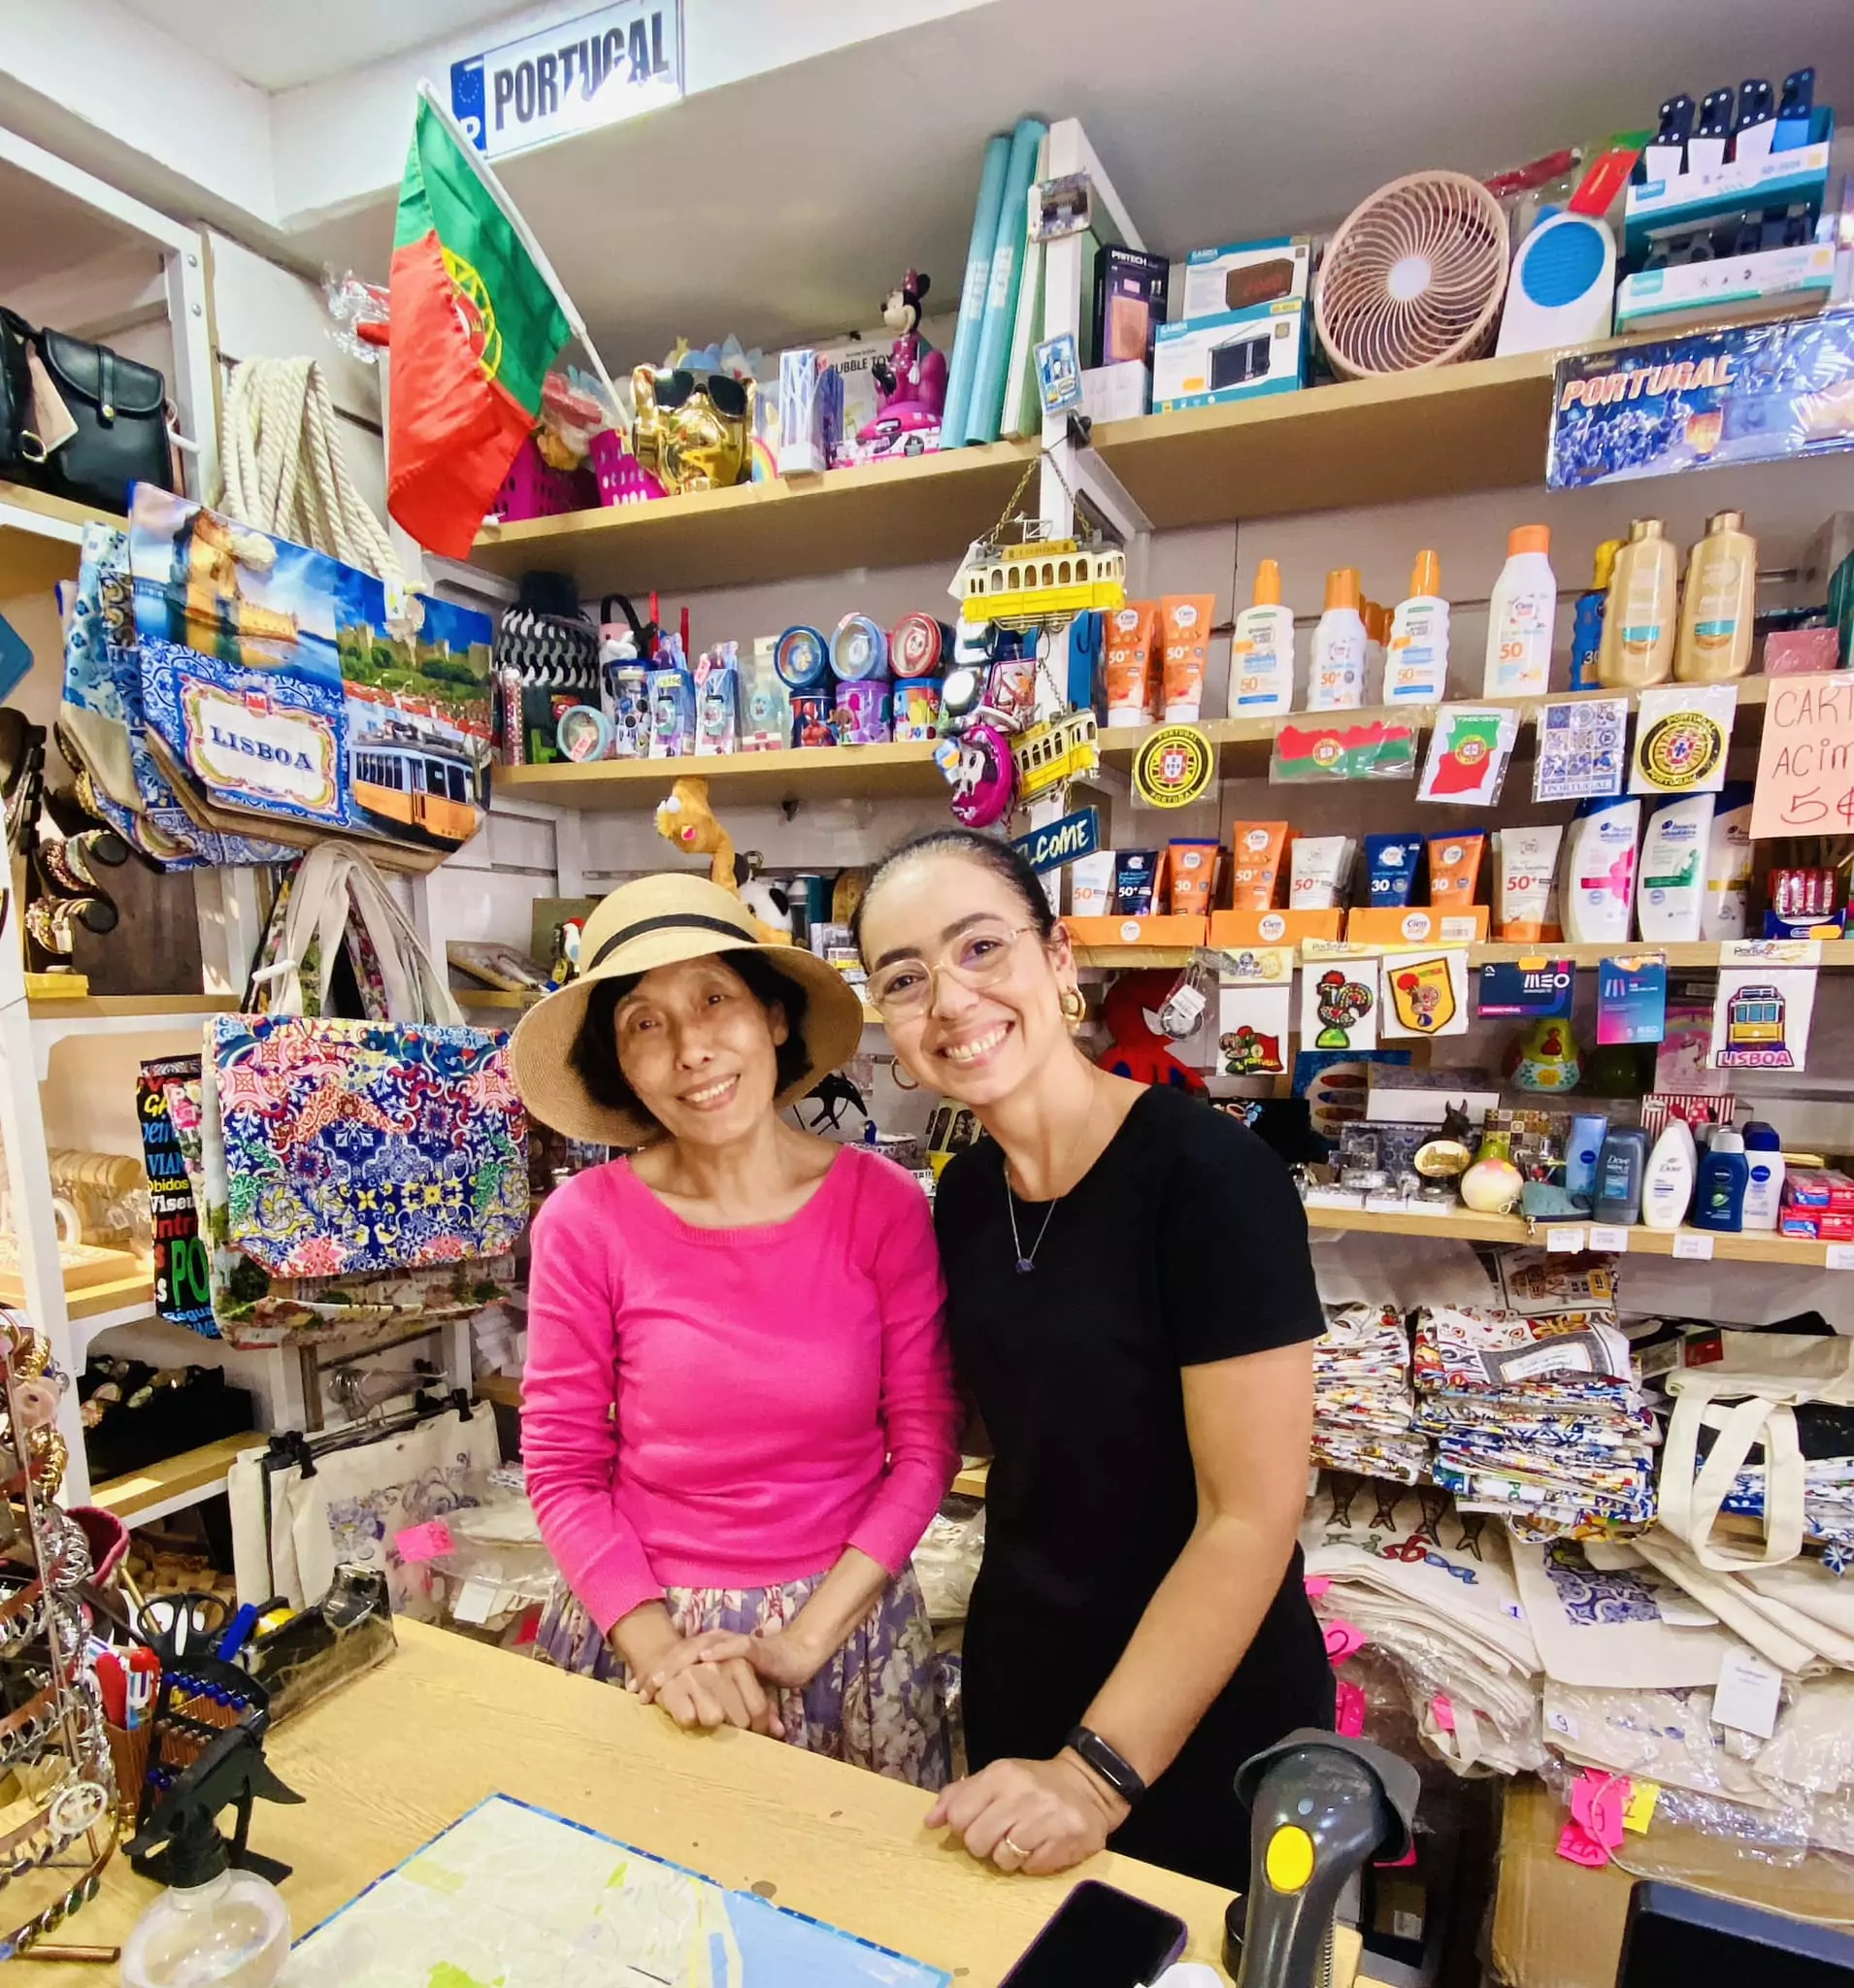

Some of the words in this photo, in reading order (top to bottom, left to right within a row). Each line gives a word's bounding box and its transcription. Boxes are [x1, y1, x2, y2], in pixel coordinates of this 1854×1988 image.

[493, 12, 670, 131] PORTUGAL
[1560, 355, 1736, 411] PORTUGAL
[1500, 642, 1523, 659] 50
[210, 724, 315, 773] LISBOA
[1546, 780, 1608, 793] PORTUGAL
[1029, 818, 1089, 866] COME
[1372, 879, 1390, 892] 30
[1506, 876, 1537, 891] 50+
[1074, 887, 1093, 900] 50
[1524, 974, 1571, 988] MEO
[1719, 1050, 1791, 1067] LISBOA
[1607, 1155, 1631, 1165] Dove
